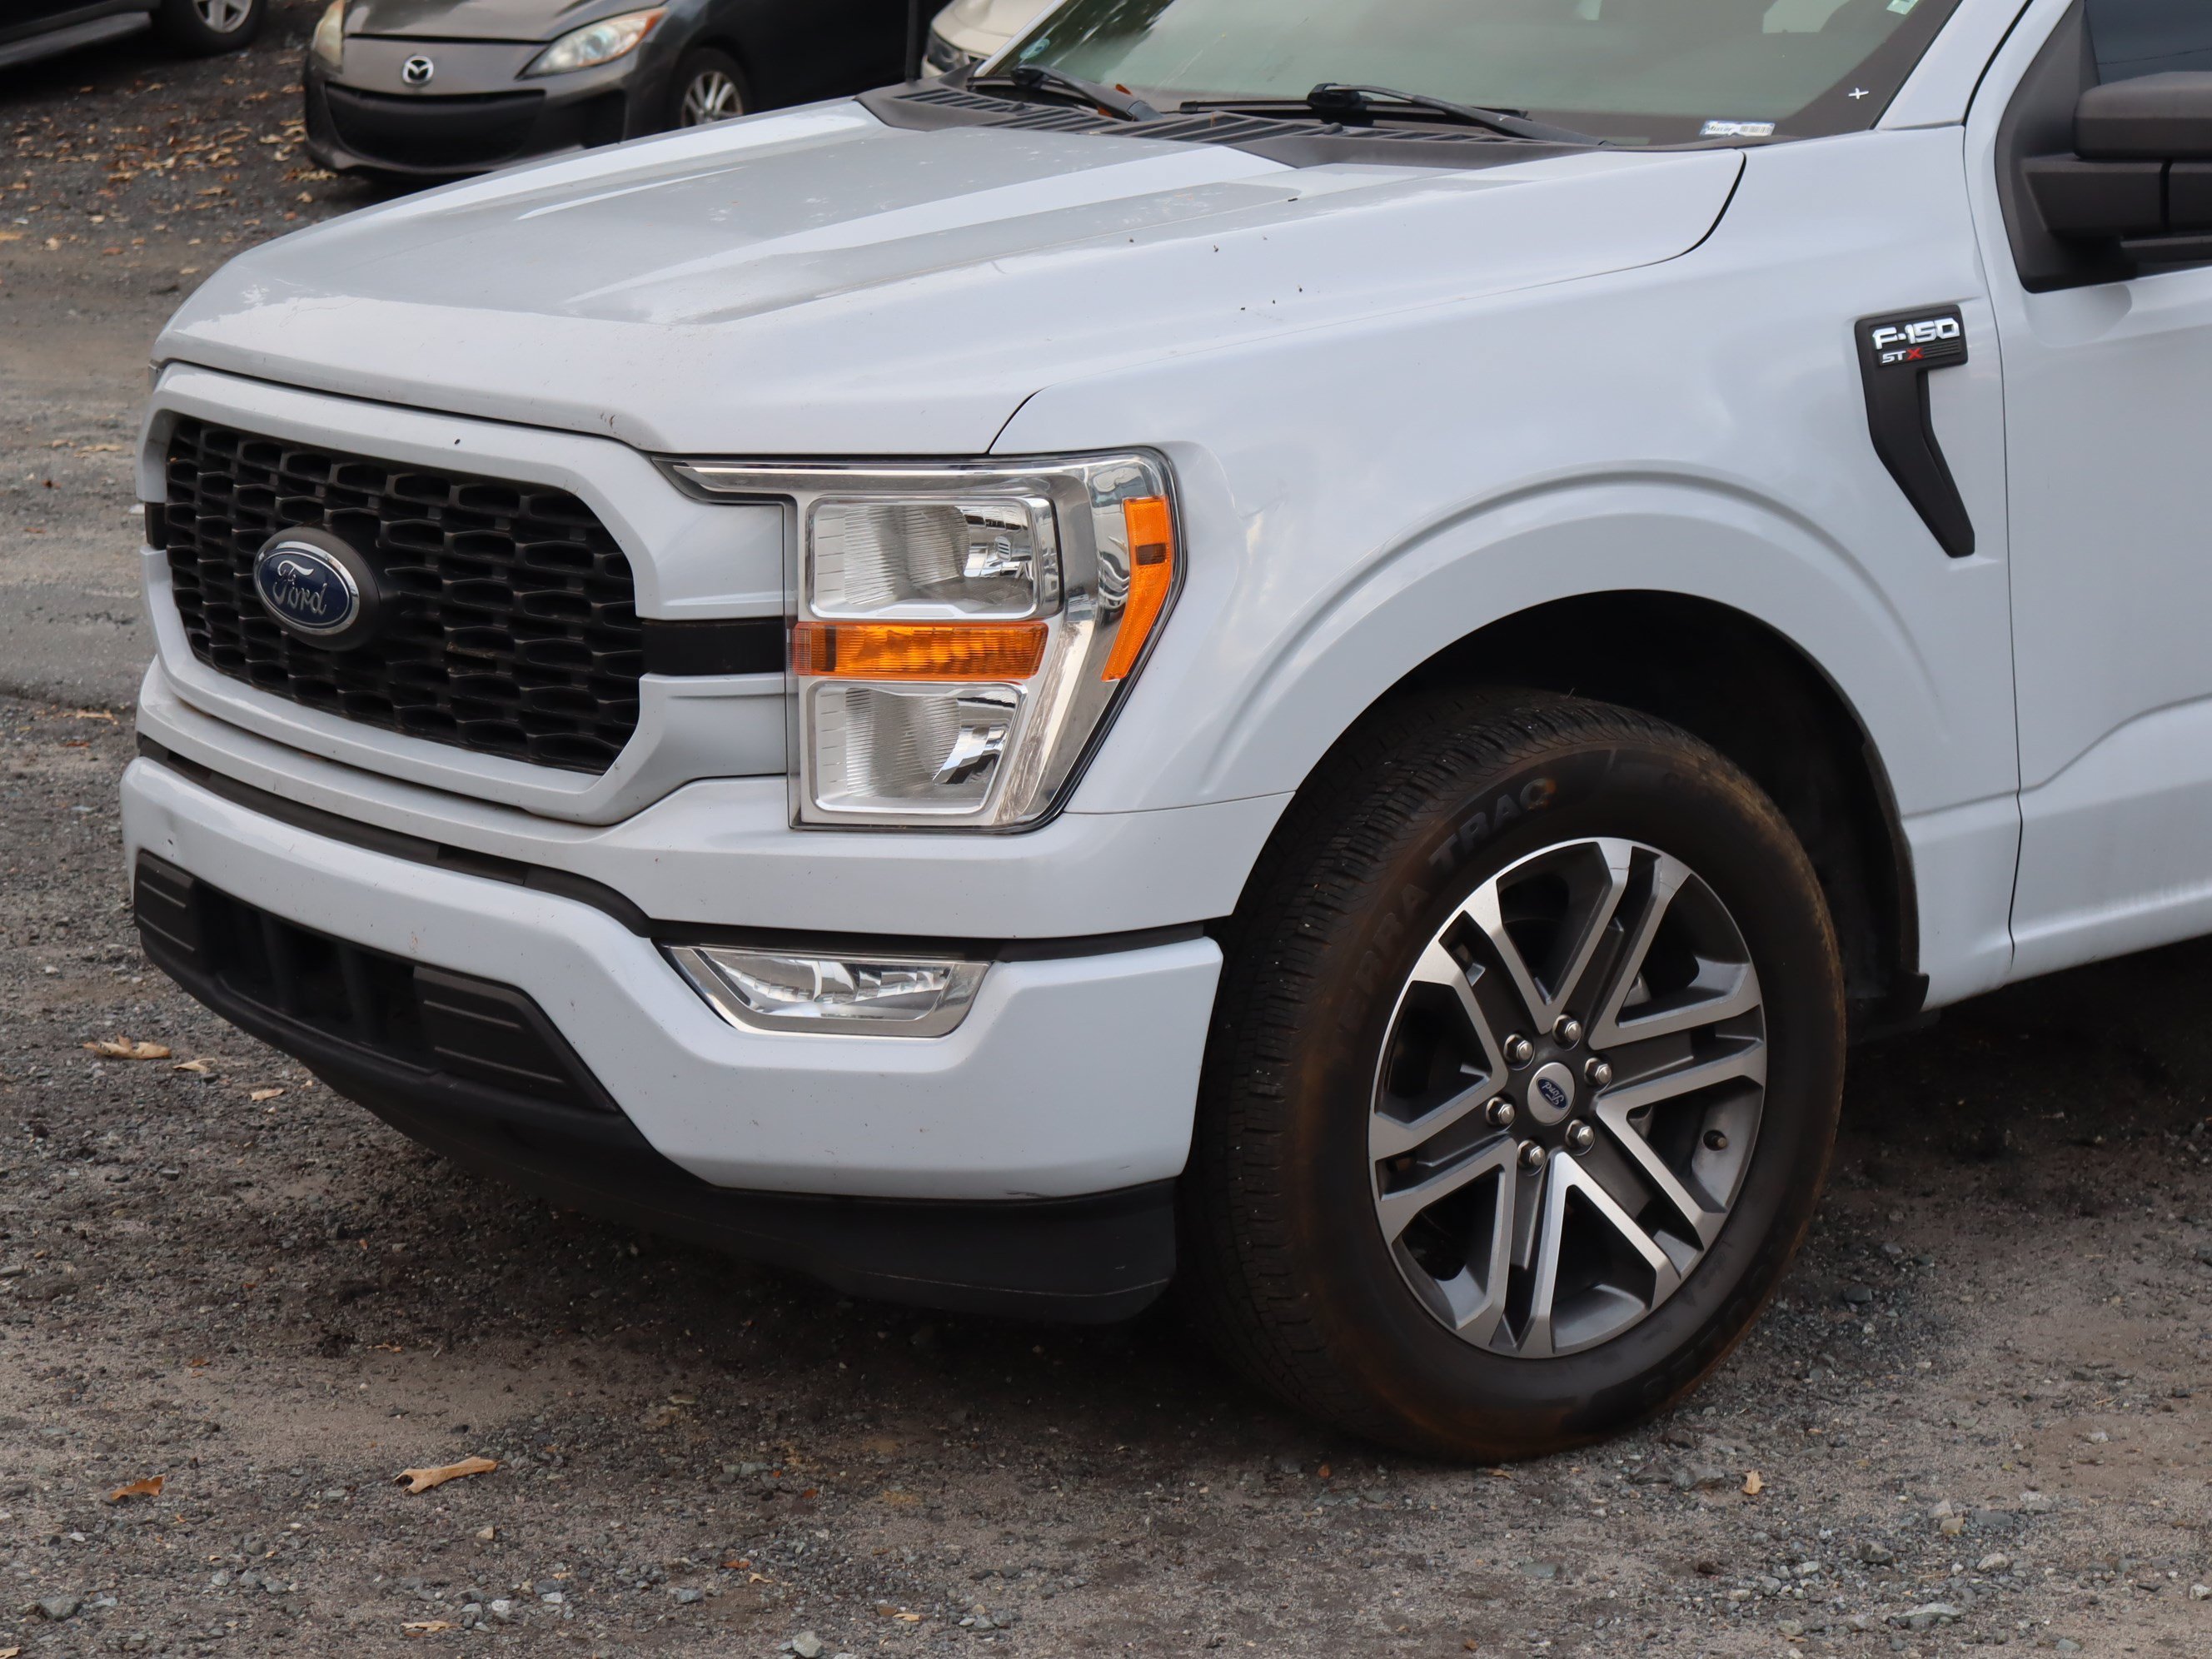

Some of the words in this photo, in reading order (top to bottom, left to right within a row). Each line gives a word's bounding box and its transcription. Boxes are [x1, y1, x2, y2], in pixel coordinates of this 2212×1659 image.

[1872, 317, 1960, 349] F-150
[1881, 347, 1924, 364] STX
[272, 560, 327, 616] Ford
[1542, 1082, 1564, 1105] Ford
